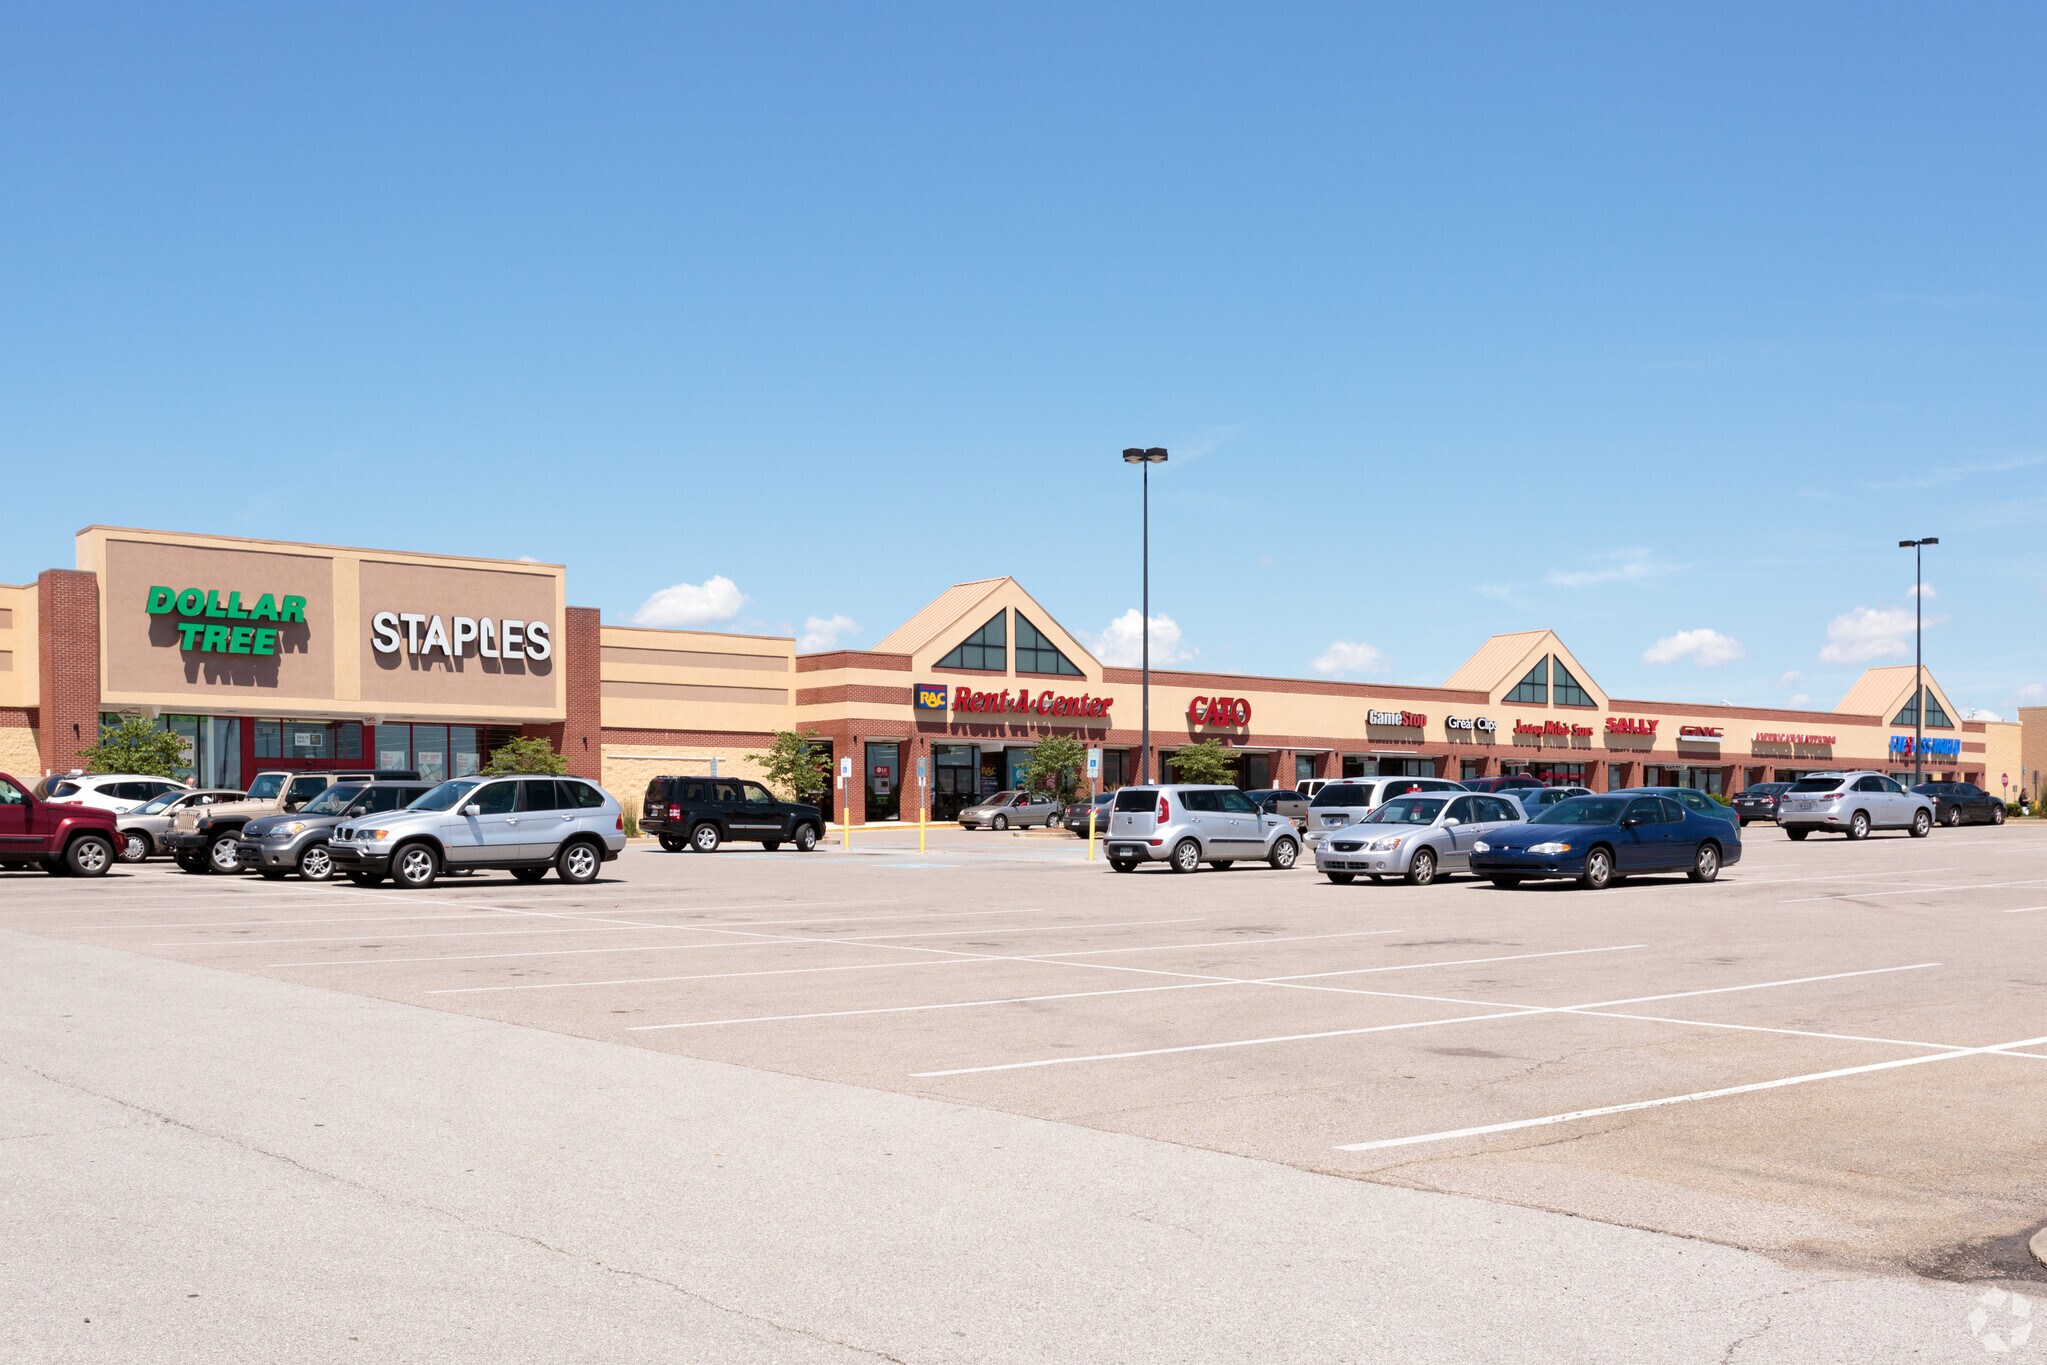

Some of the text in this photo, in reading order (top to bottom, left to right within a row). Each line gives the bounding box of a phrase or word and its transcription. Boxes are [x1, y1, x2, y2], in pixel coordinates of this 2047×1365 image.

[145, 585, 307, 623] DOLLAR
[177, 622, 277, 655] TREE
[372, 611, 552, 661] STAPLES
[920, 691, 946, 708] RAC
[1190, 695, 1252, 727] CATO
[1368, 709, 1427, 728] GameStop
[1447, 716, 1498, 733] Great Clips
[1605, 717, 1660, 732] SALLY
[1680, 725, 1725, 738] GNC
[981, 766, 996, 776] RAC
